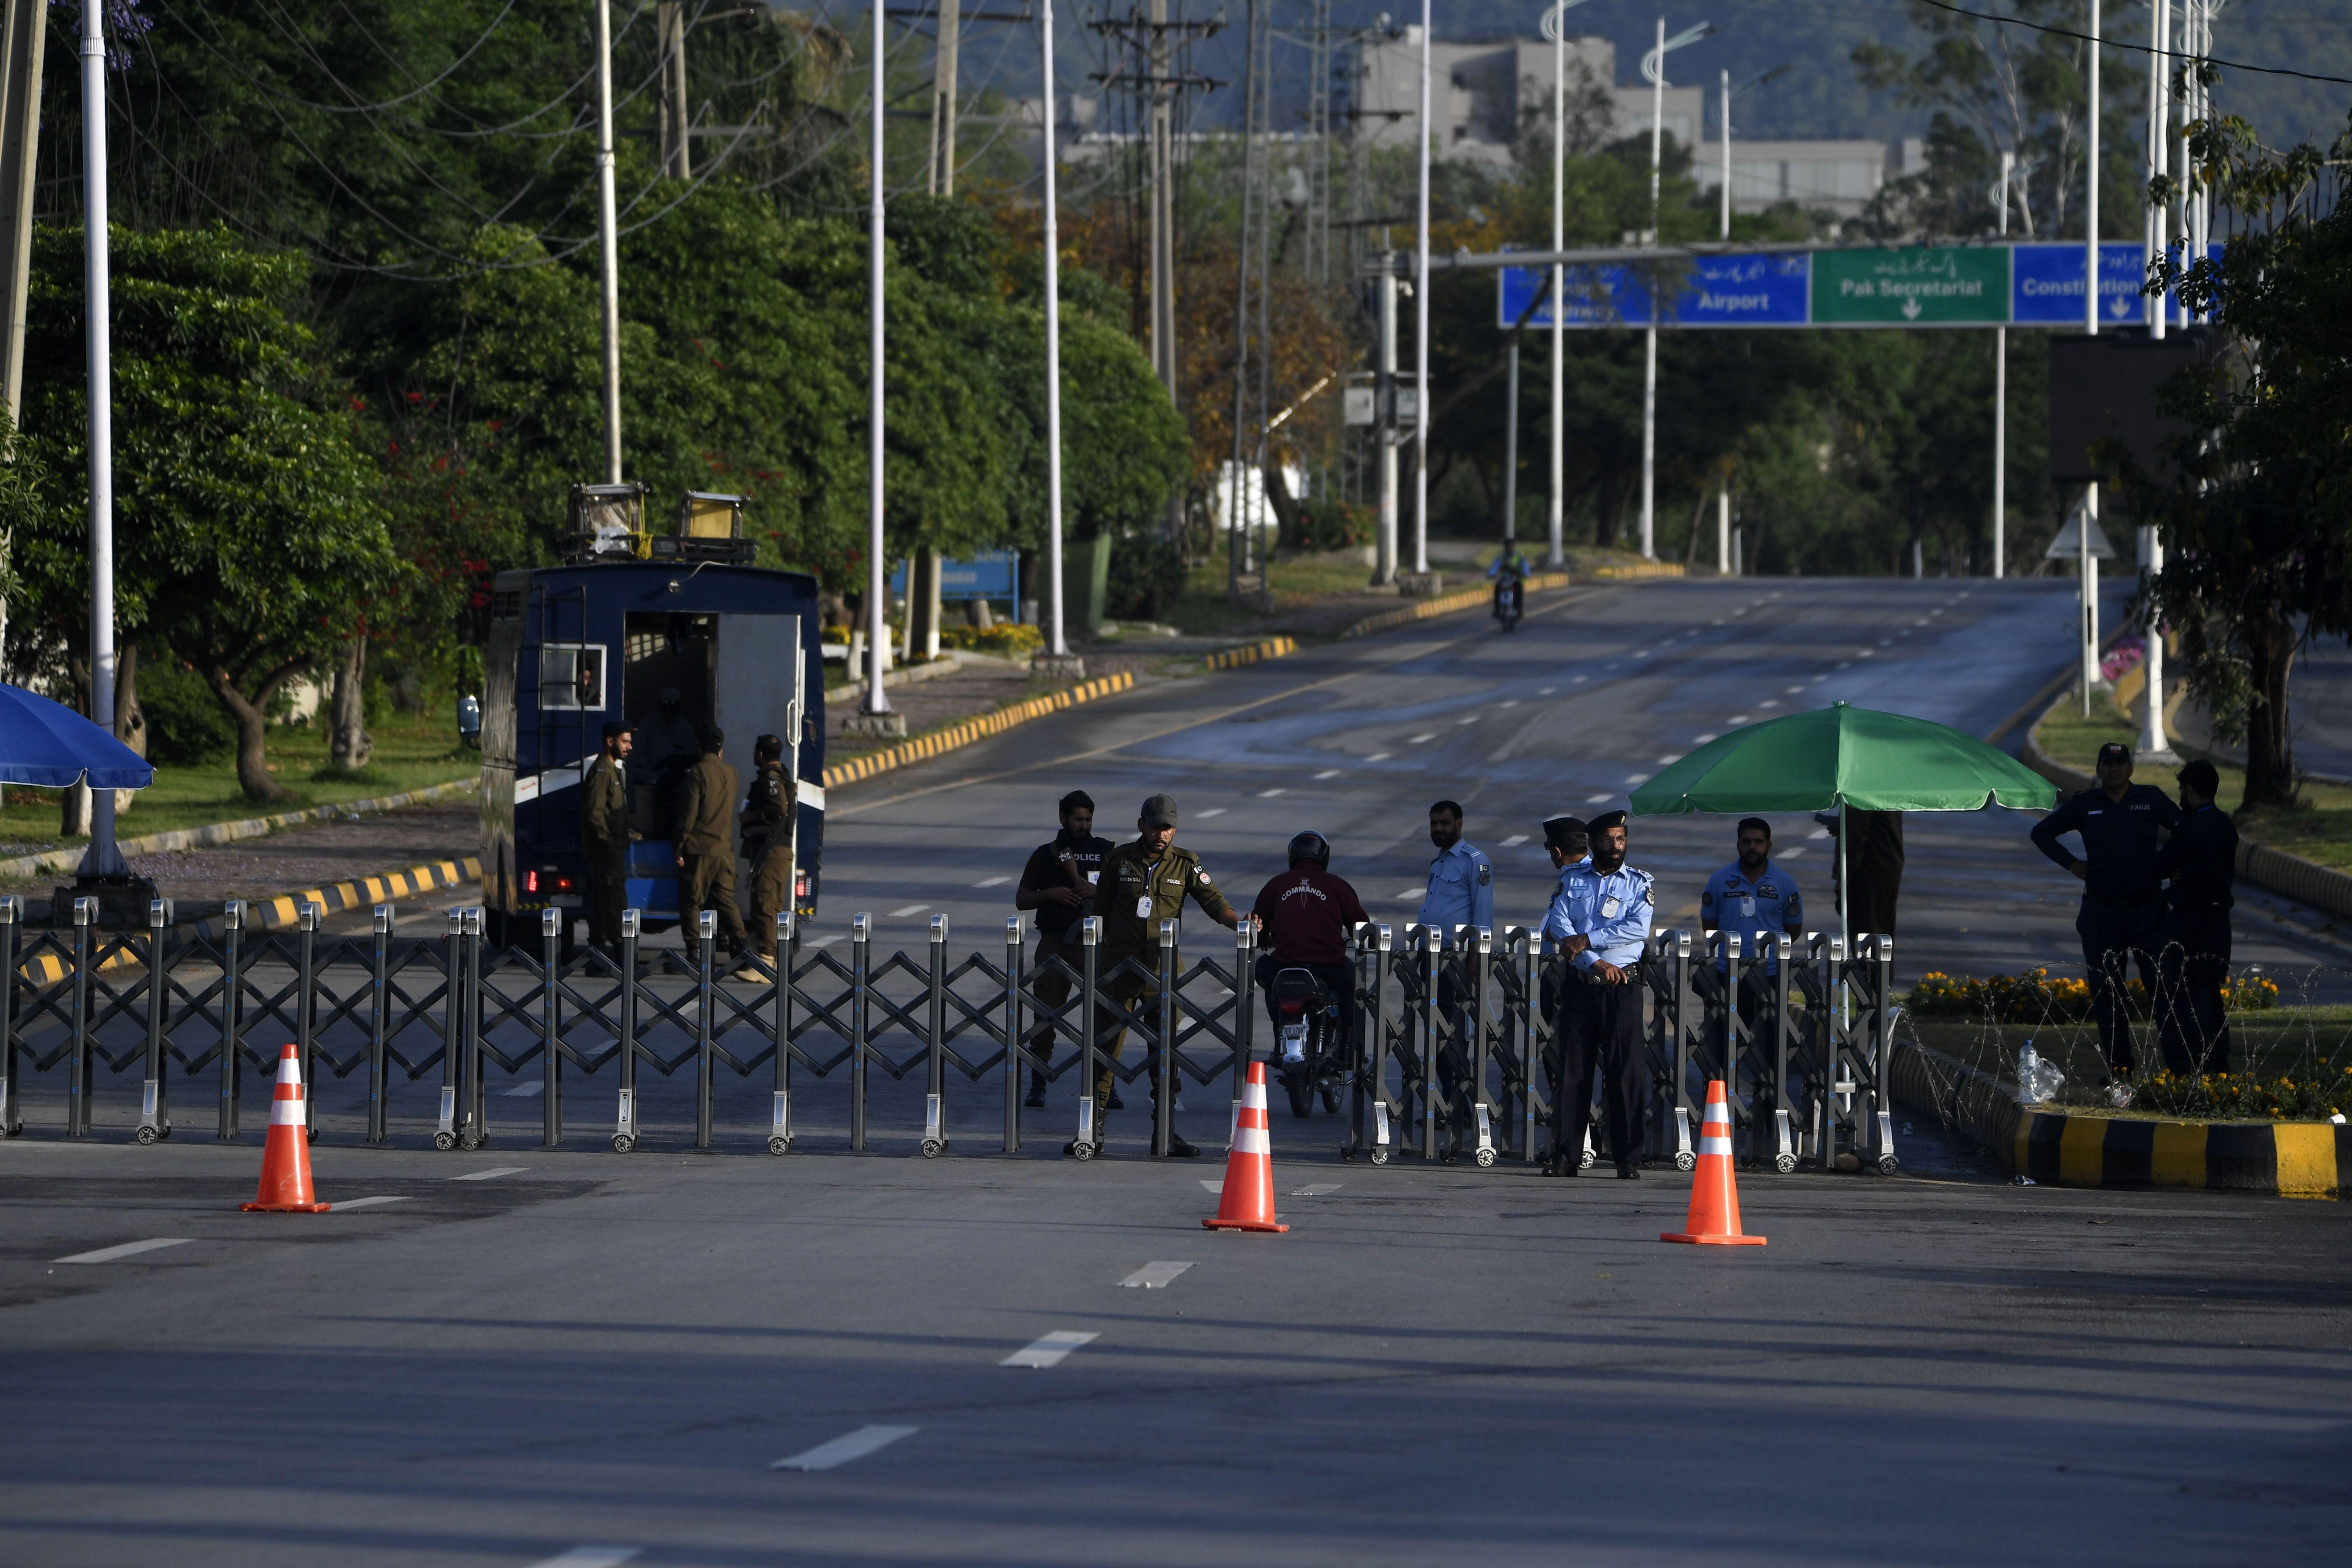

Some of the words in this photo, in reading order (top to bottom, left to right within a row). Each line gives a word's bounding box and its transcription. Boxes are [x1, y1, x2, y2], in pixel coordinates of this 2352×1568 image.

[1698, 292, 1769, 313] Airport
[1840, 278, 1876, 296] Pak
[1880, 278, 1983, 296] Secretariat
[2022, 277, 2140, 297] Constition
[1073, 853, 1101, 862] OLICE
[1281, 886, 1327, 901] COMMANDO
[72, 943, 82, 1094] POLICE
[222, 947, 232, 1097] POLICE
[372, 950, 382, 1100] POLICE
[1427, 969, 1436, 1119] POLICE
[1527, 971, 1536, 1120] POLICE
[1728, 976, 1736, 1124] POLICE
[1828, 978, 1838, 1127] POLICE
